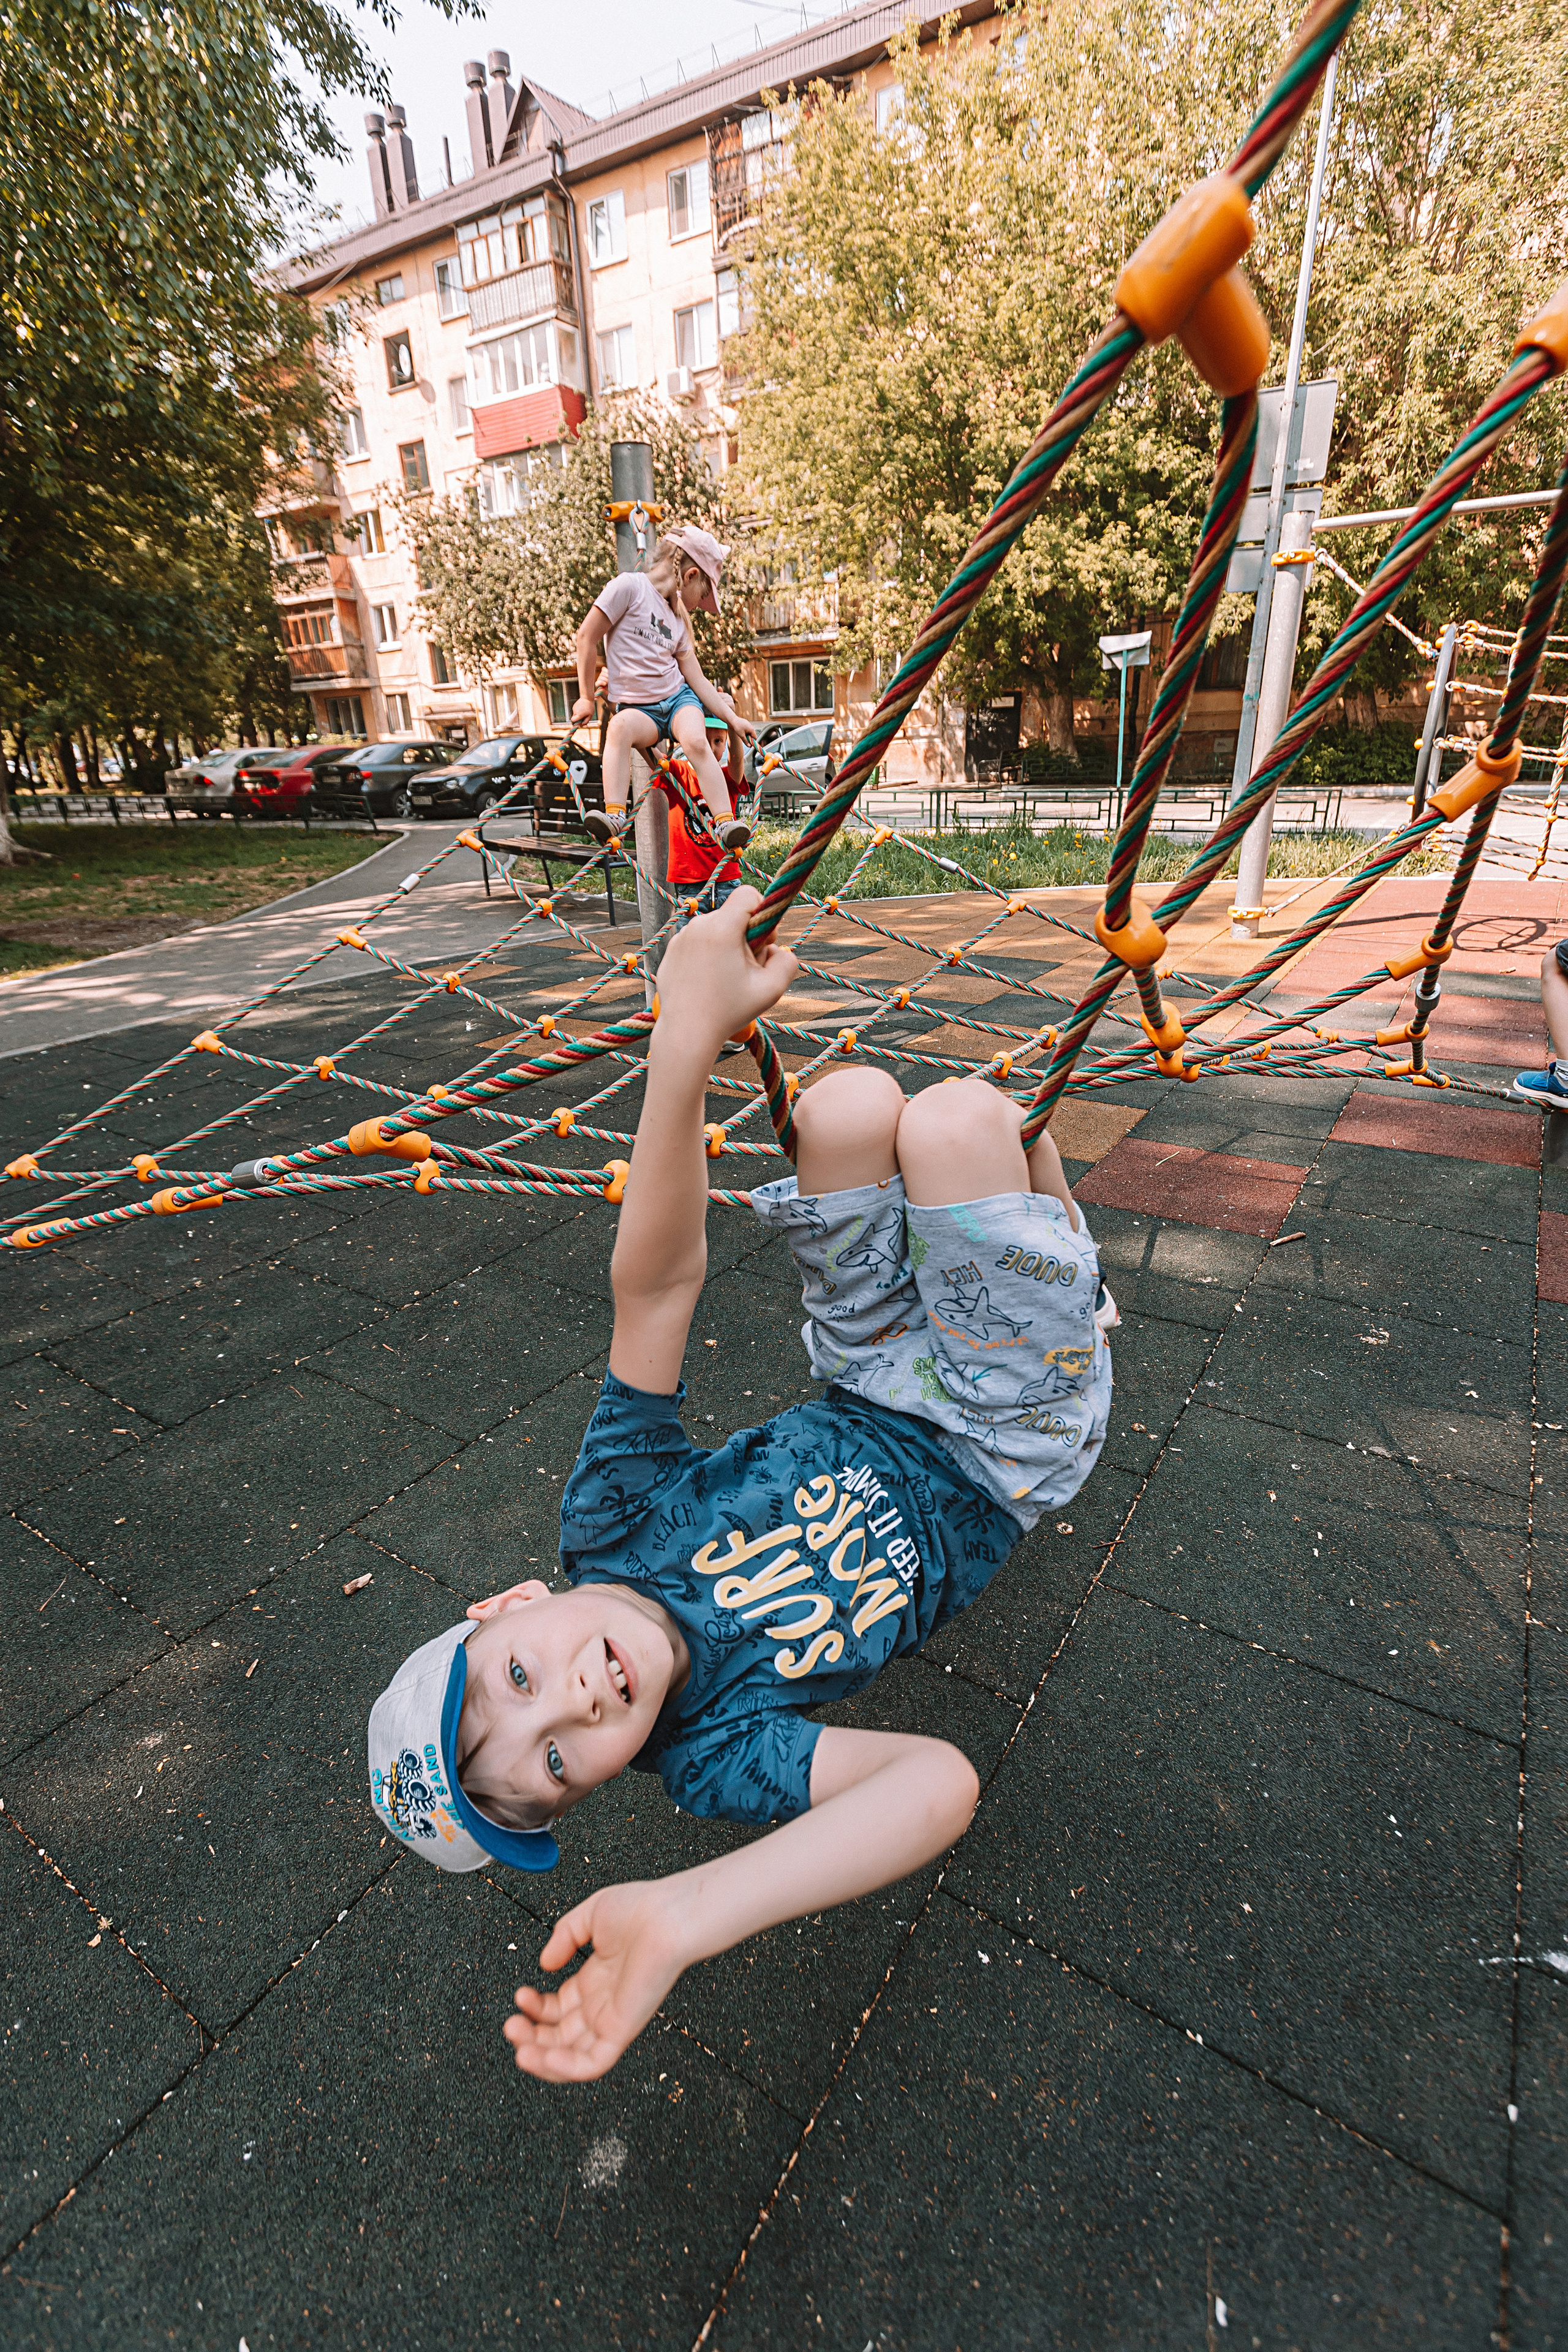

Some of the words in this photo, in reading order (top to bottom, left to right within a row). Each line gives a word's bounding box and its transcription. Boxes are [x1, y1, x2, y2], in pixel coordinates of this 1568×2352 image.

[644, 631, 654, 641] LAZY
[940, 1261, 983, 1287] HEY
[995, 1245, 1077, 1287] DUDE
[827, 1303, 855, 1314] good
[1014, 1406, 1082, 1447] DUDE
[652, 1502, 698, 1552] BEACH
[867, 1507, 903, 1539] IT
[963, 1539, 999, 1564] TEAM
[691, 1523, 845, 1678] SURF
[704, 1606, 745, 1648] Coast
[423, 1744, 448, 1796] SAND
[740, 1757, 799, 1812] sunny
